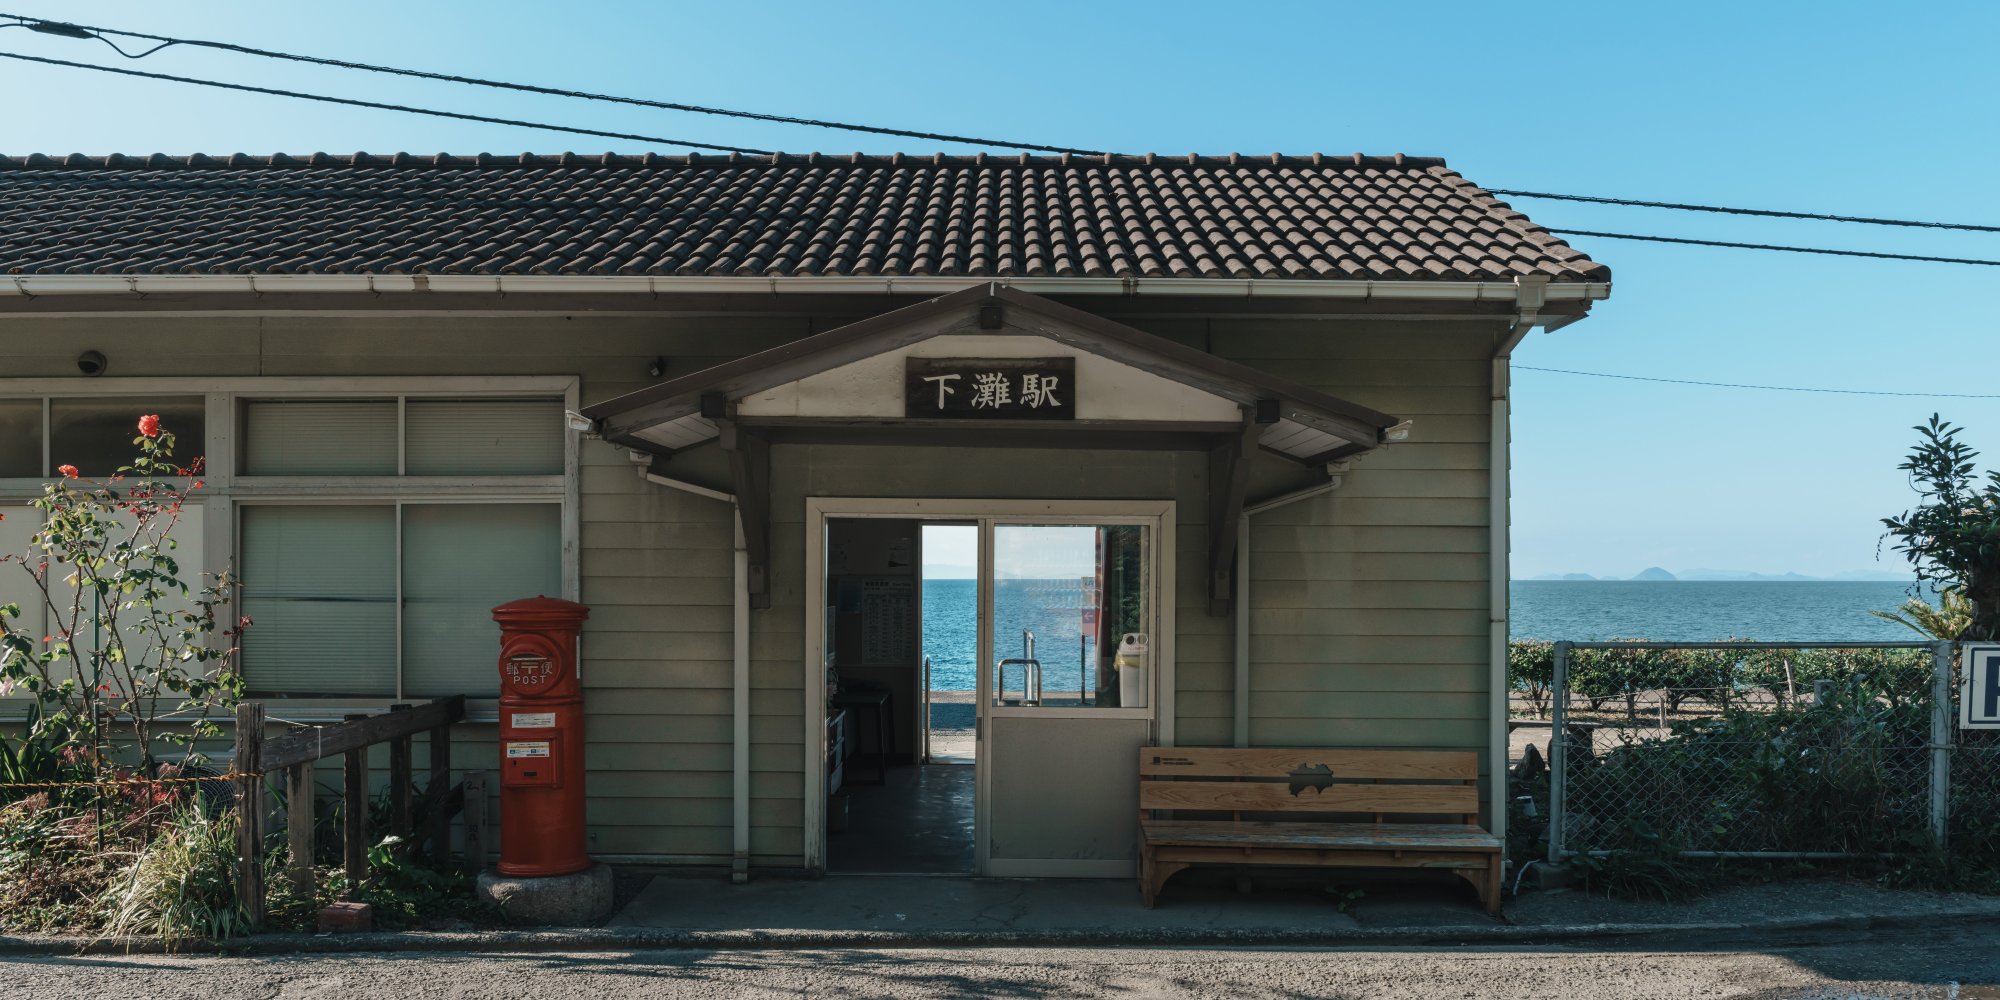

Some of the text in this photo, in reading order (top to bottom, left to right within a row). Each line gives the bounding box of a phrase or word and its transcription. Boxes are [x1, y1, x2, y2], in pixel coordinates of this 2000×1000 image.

[922, 371, 1062, 410] 下灘駅
[512, 674, 547, 685] POST
